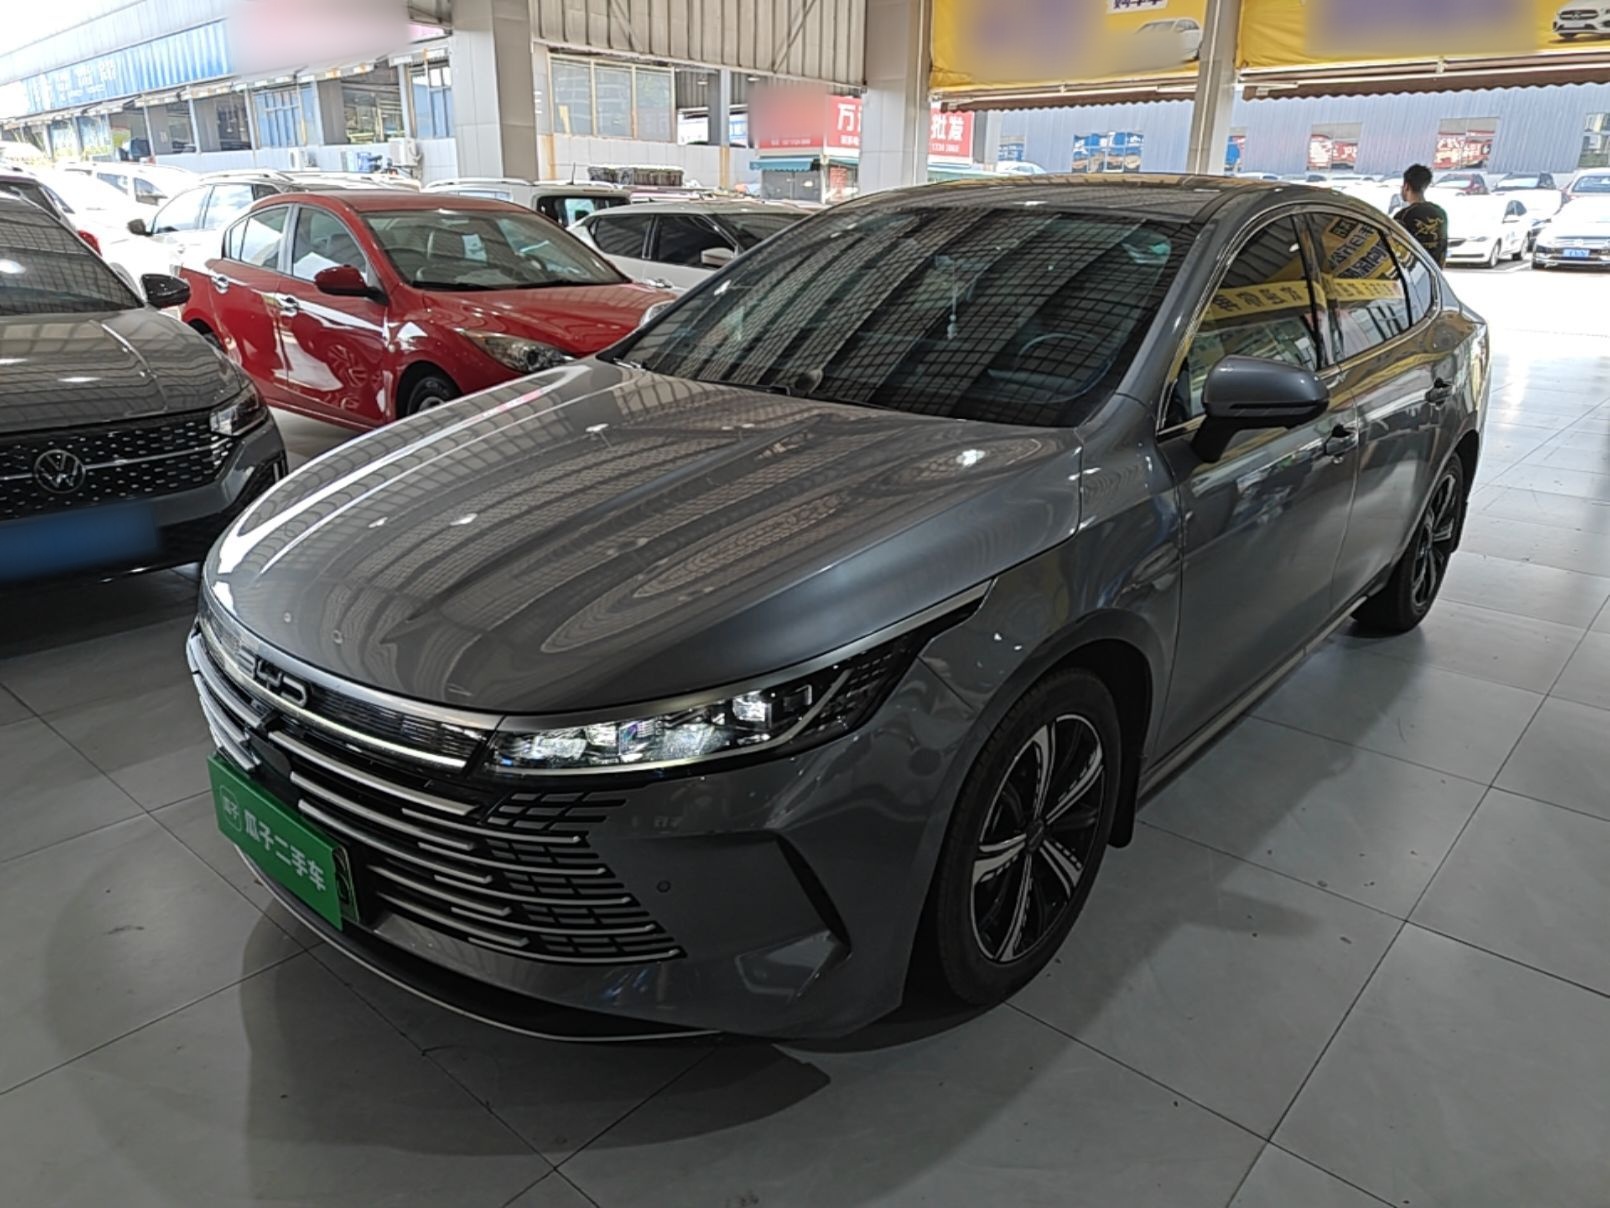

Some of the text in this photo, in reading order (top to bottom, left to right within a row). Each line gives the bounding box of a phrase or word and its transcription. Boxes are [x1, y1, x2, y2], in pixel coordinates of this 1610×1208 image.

[837, 103, 965, 142] 万 批发
[243, 809, 326, 891] 瓜子二手车
